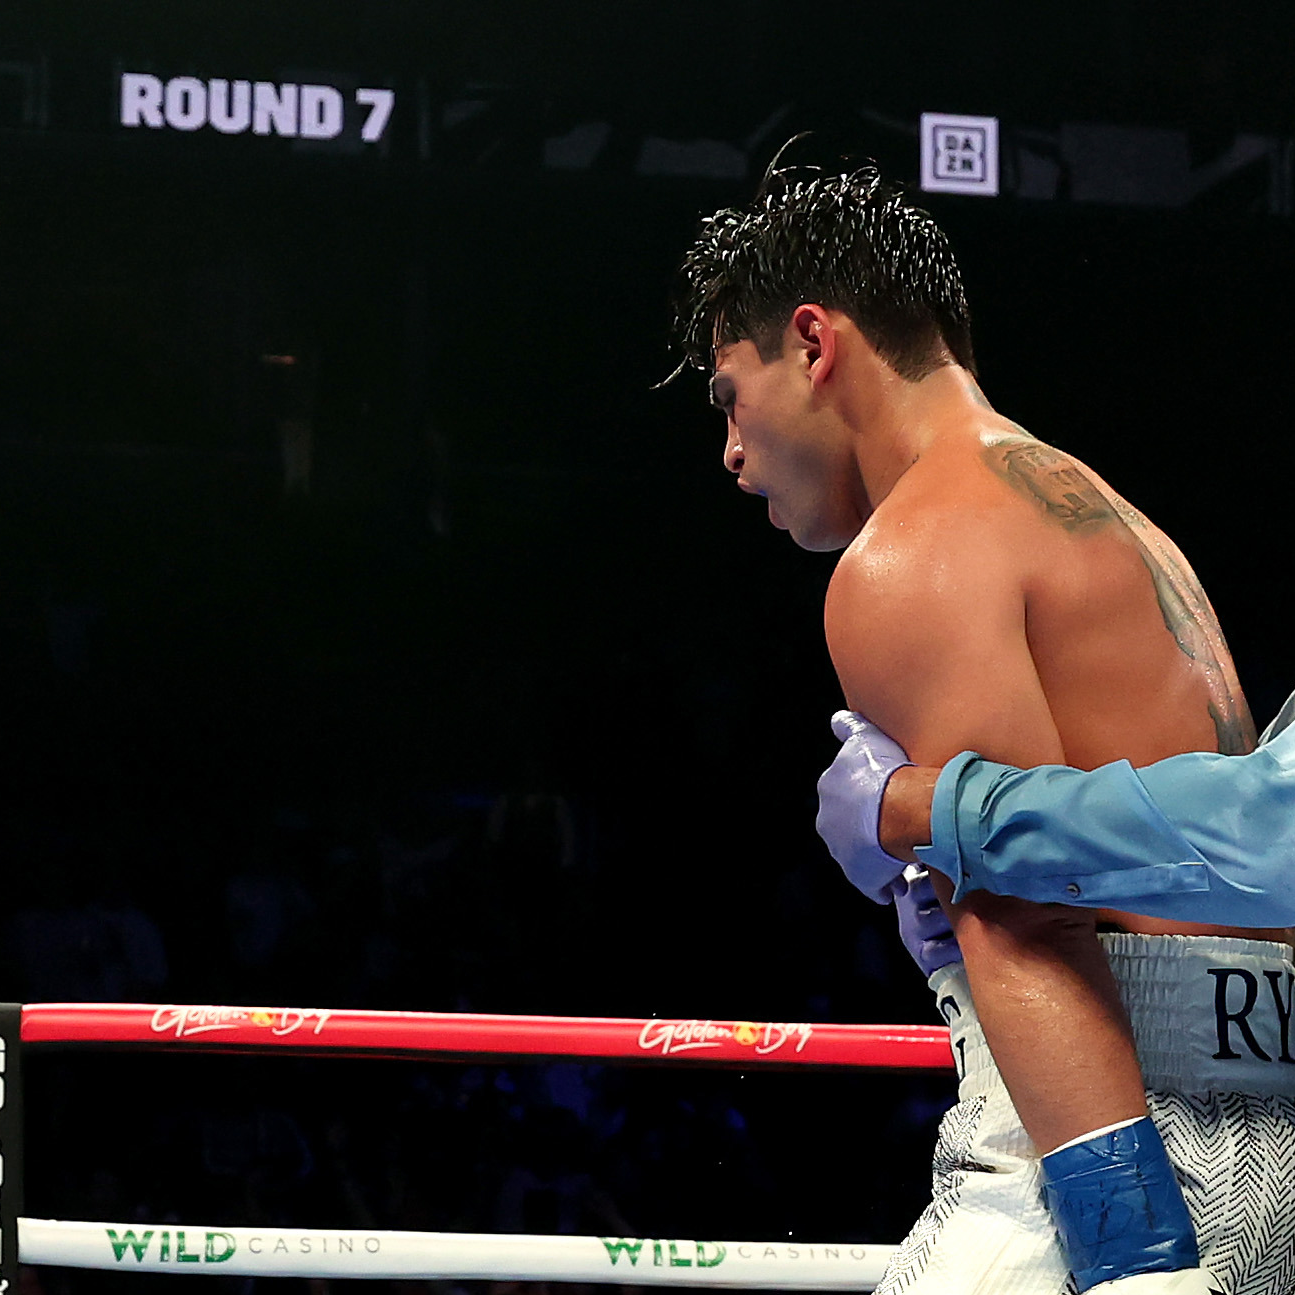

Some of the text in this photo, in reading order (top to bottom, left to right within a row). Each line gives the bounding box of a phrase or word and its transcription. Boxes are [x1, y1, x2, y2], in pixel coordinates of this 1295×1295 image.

[120, 72, 395, 142] ROUND 7
[638, 1019, 813, 1054] Golden Boy
[106, 1229, 381, 1263] WILD CASINO
[600, 1237, 727, 1267] WILD
